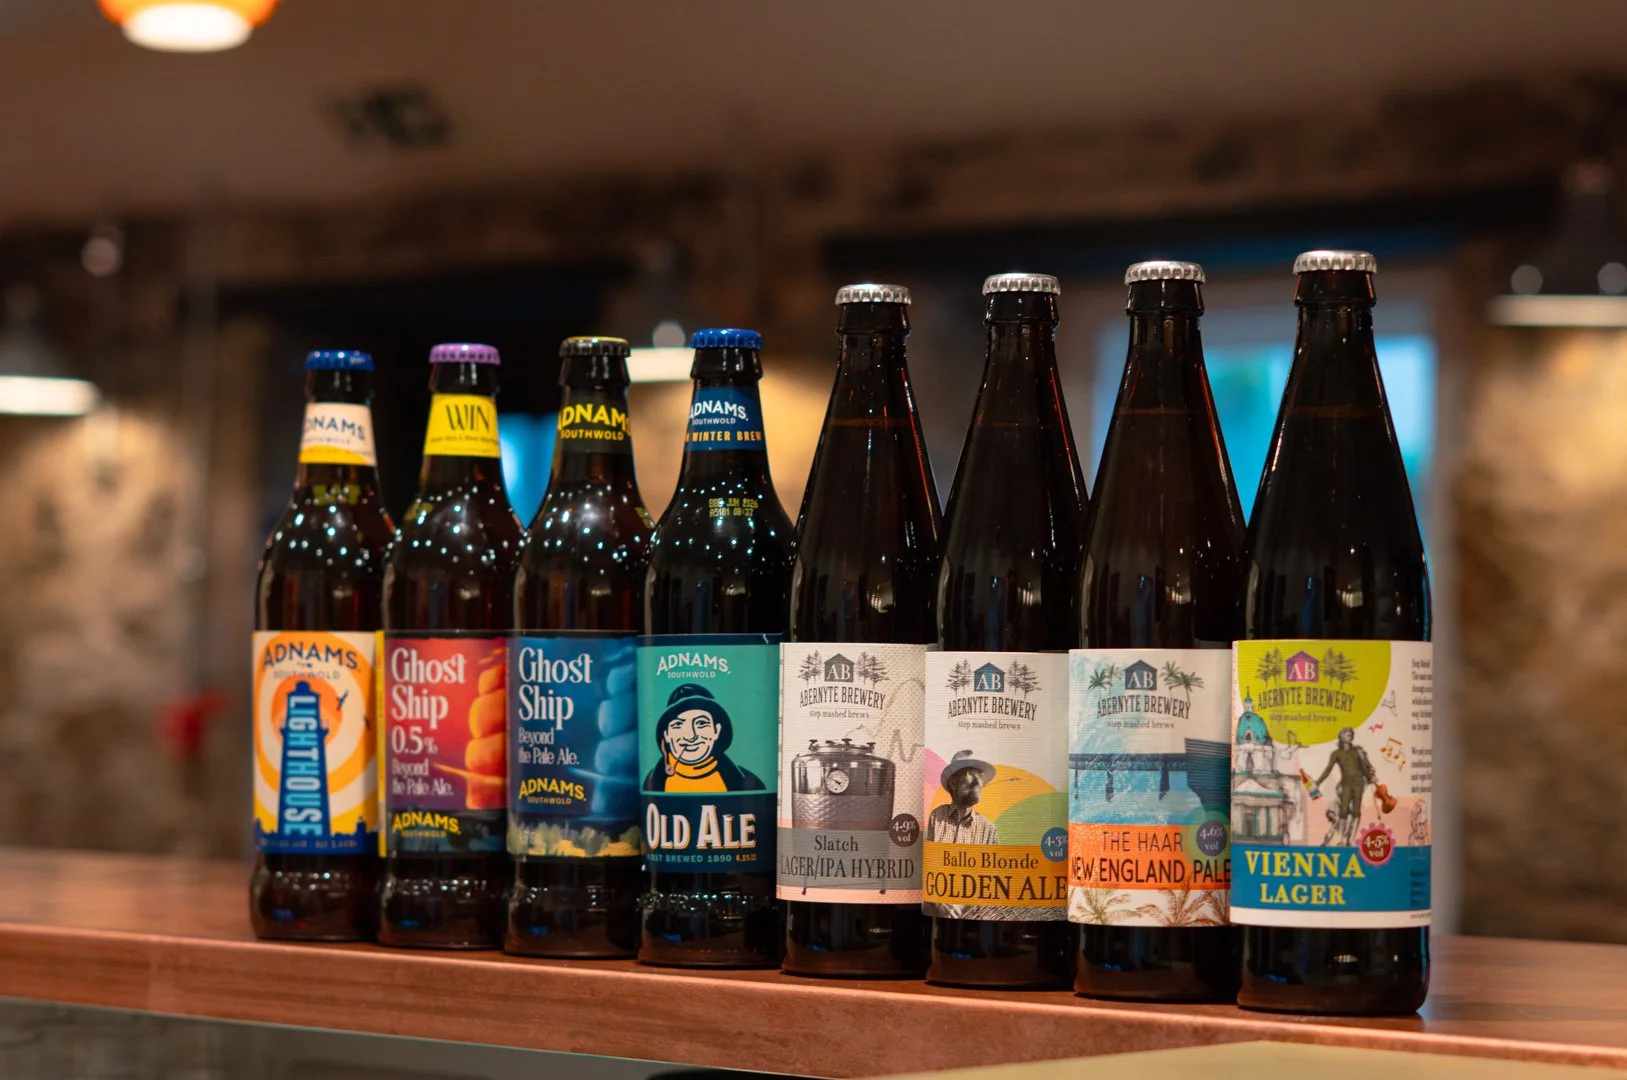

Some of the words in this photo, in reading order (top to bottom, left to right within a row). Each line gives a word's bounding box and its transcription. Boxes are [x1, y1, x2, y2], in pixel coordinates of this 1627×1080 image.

[445, 404, 490, 433] WIN
[561, 429, 624, 440] SOUTHWOLD
[692, 431, 731, 442] WINTER
[391, 647, 466, 684] Ghost
[518, 646, 594, 684] Ghost
[667, 671, 716, 679] SOUTHWOLD
[826, 663, 851, 680] AB
[1288, 662, 1316, 680] AB
[976, 673, 1001, 690] AB
[1128, 671, 1154, 688] AB
[391, 684, 449, 730] Ship
[518, 684, 575, 731] Ship
[799, 686, 839, 707] ABERNYTE
[841, 686, 885, 710] BREWERY
[948, 696, 989, 719] ABERNYTE
[991, 697, 1038, 721] BREWERY
[1096, 695, 1141, 719] ABERNYTE
[1144, 695, 1191, 720] BREWERY
[1257, 686, 1302, 710] ABERNYTE
[1305, 687, 1355, 712] BREWERY
[391, 725, 439, 755] 0.5%
[518, 726, 555, 748] Beyond
[284, 695, 323, 837] LIGHTHOUSE
[532, 746, 555, 765] Pale
[556, 746, 580, 766] Ale.
[646, 803, 691, 850] OLD
[696, 804, 757, 850] ALE
[814, 834, 859, 852] Slatch
[897, 833, 911, 842] vol
[1102, 831, 1131, 851] THE
[1138, 832, 1183, 852] HAAR
[1204, 841, 1219, 850] vol
[665, 854, 704, 863] BREWED
[707, 854, 732, 862] 1890
[943, 850, 977, 868] Ballo
[981, 852, 1039, 869] Blonde
[1050, 848, 1063, 857] vol
[1368, 847, 1384, 857] vol
[851, 858, 914, 879] HYBRID
[1071, 856, 1095, 880] NEW
[1100, 858, 1185, 884] ENGLAND
[1193, 859, 1231, 883] PALE
[1245, 850, 1366, 878] VIENNA
[926, 872, 1012, 900] GOLDEN
[1017, 876, 1068, 901] ALE
[1260, 883, 1346, 905] LAGER
